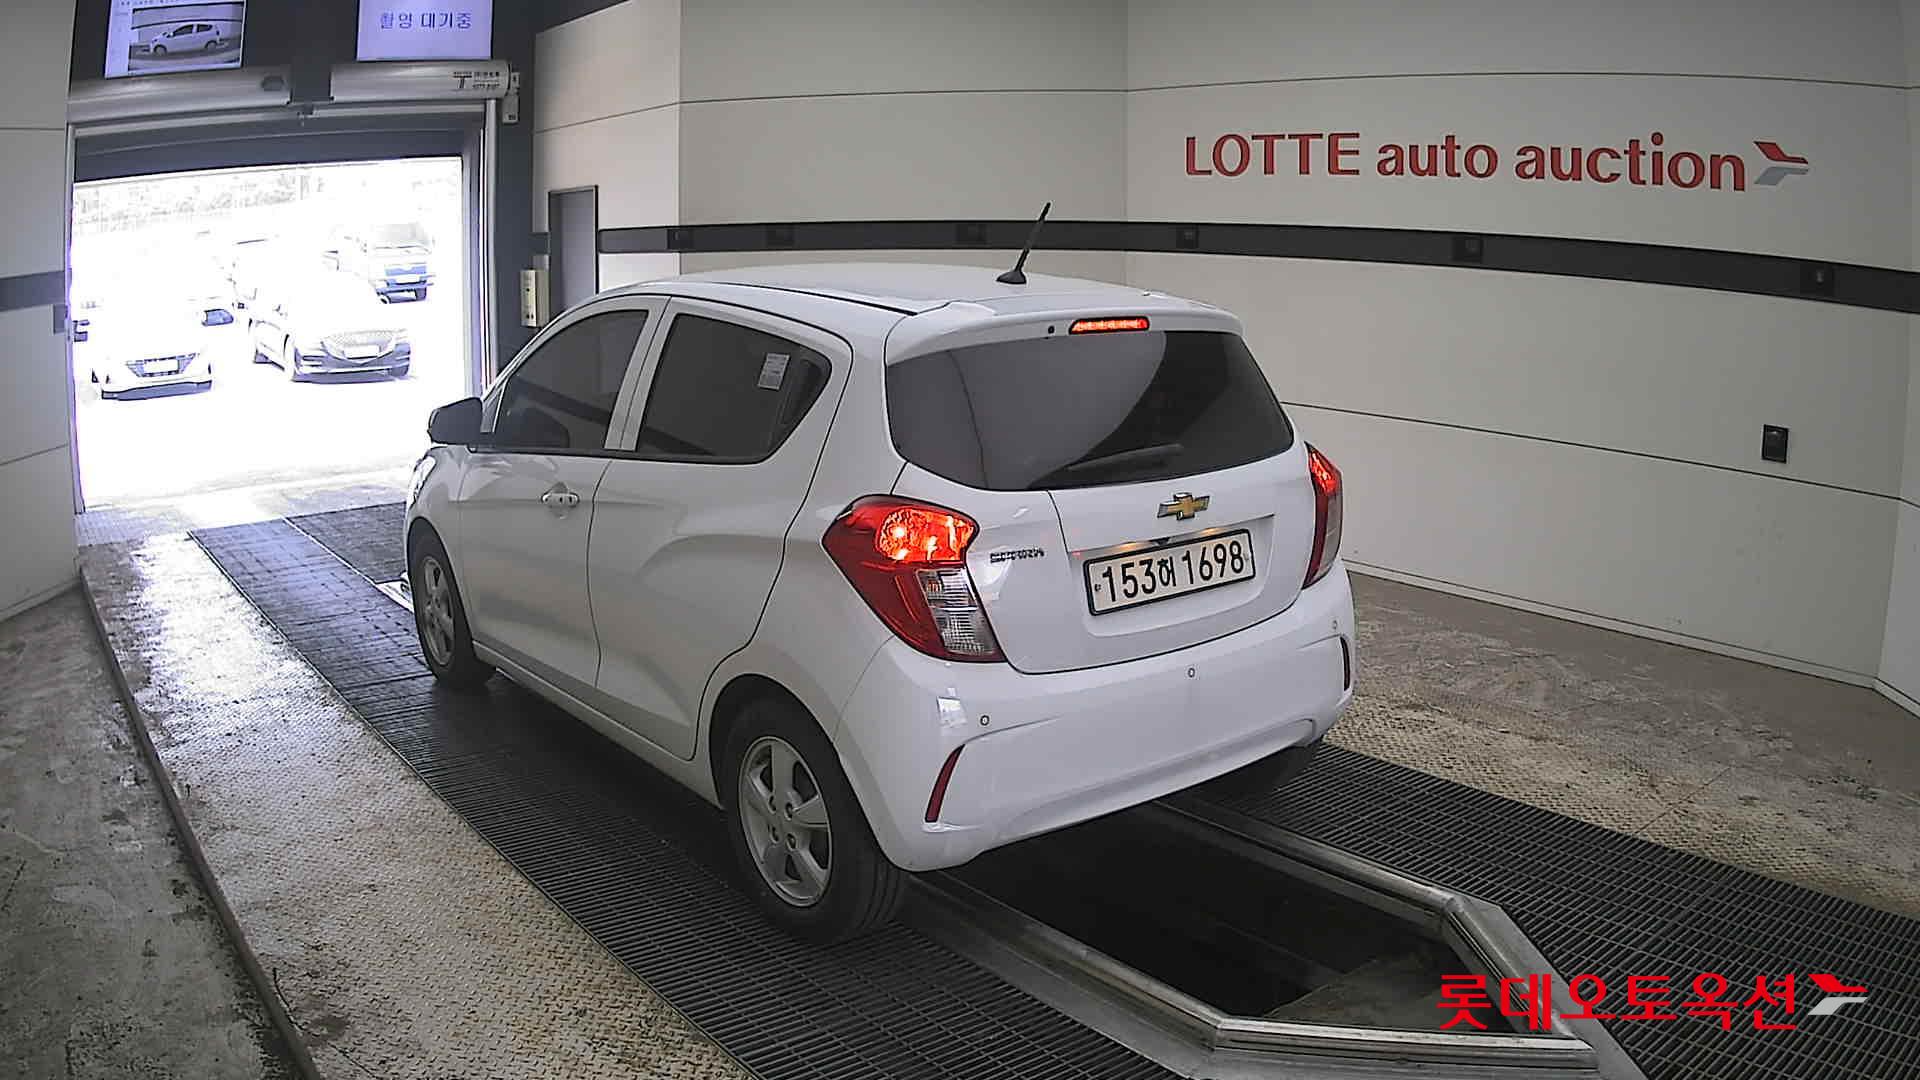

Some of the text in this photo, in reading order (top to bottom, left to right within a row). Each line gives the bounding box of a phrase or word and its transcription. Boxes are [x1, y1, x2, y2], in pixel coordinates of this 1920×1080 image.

[420, 12, 473, 30] 대기중
[1185, 131, 1746, 191] LOTTE auto auction
[1181, 540, 1244, 584] 1698
